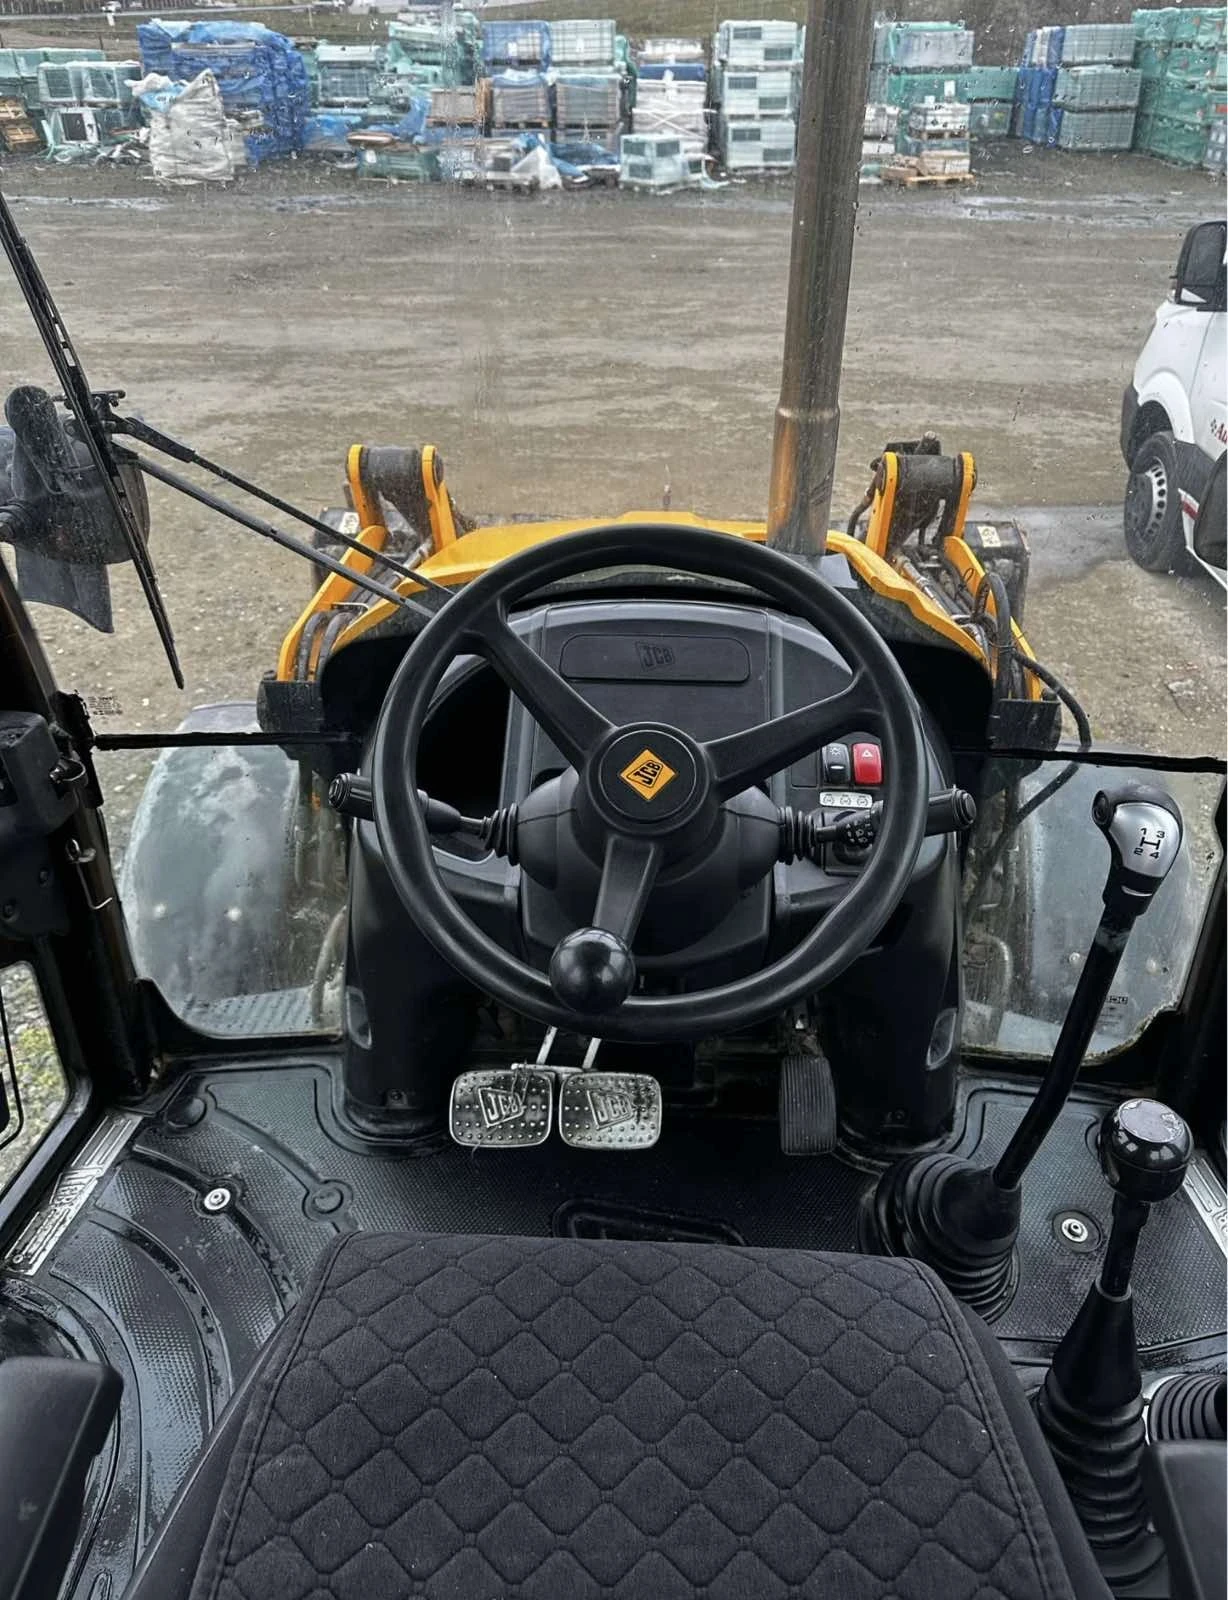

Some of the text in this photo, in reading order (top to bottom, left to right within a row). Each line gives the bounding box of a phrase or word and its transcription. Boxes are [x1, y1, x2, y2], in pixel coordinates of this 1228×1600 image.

[643, 645, 673, 662] JCB
[633, 762, 661, 785] JCB
[1156, 830, 1165, 839] 3
[1134, 847, 1160, 859] 2 4
[487, 1093, 519, 1120] JCB
[593, 1093, 629, 1121] JCB
